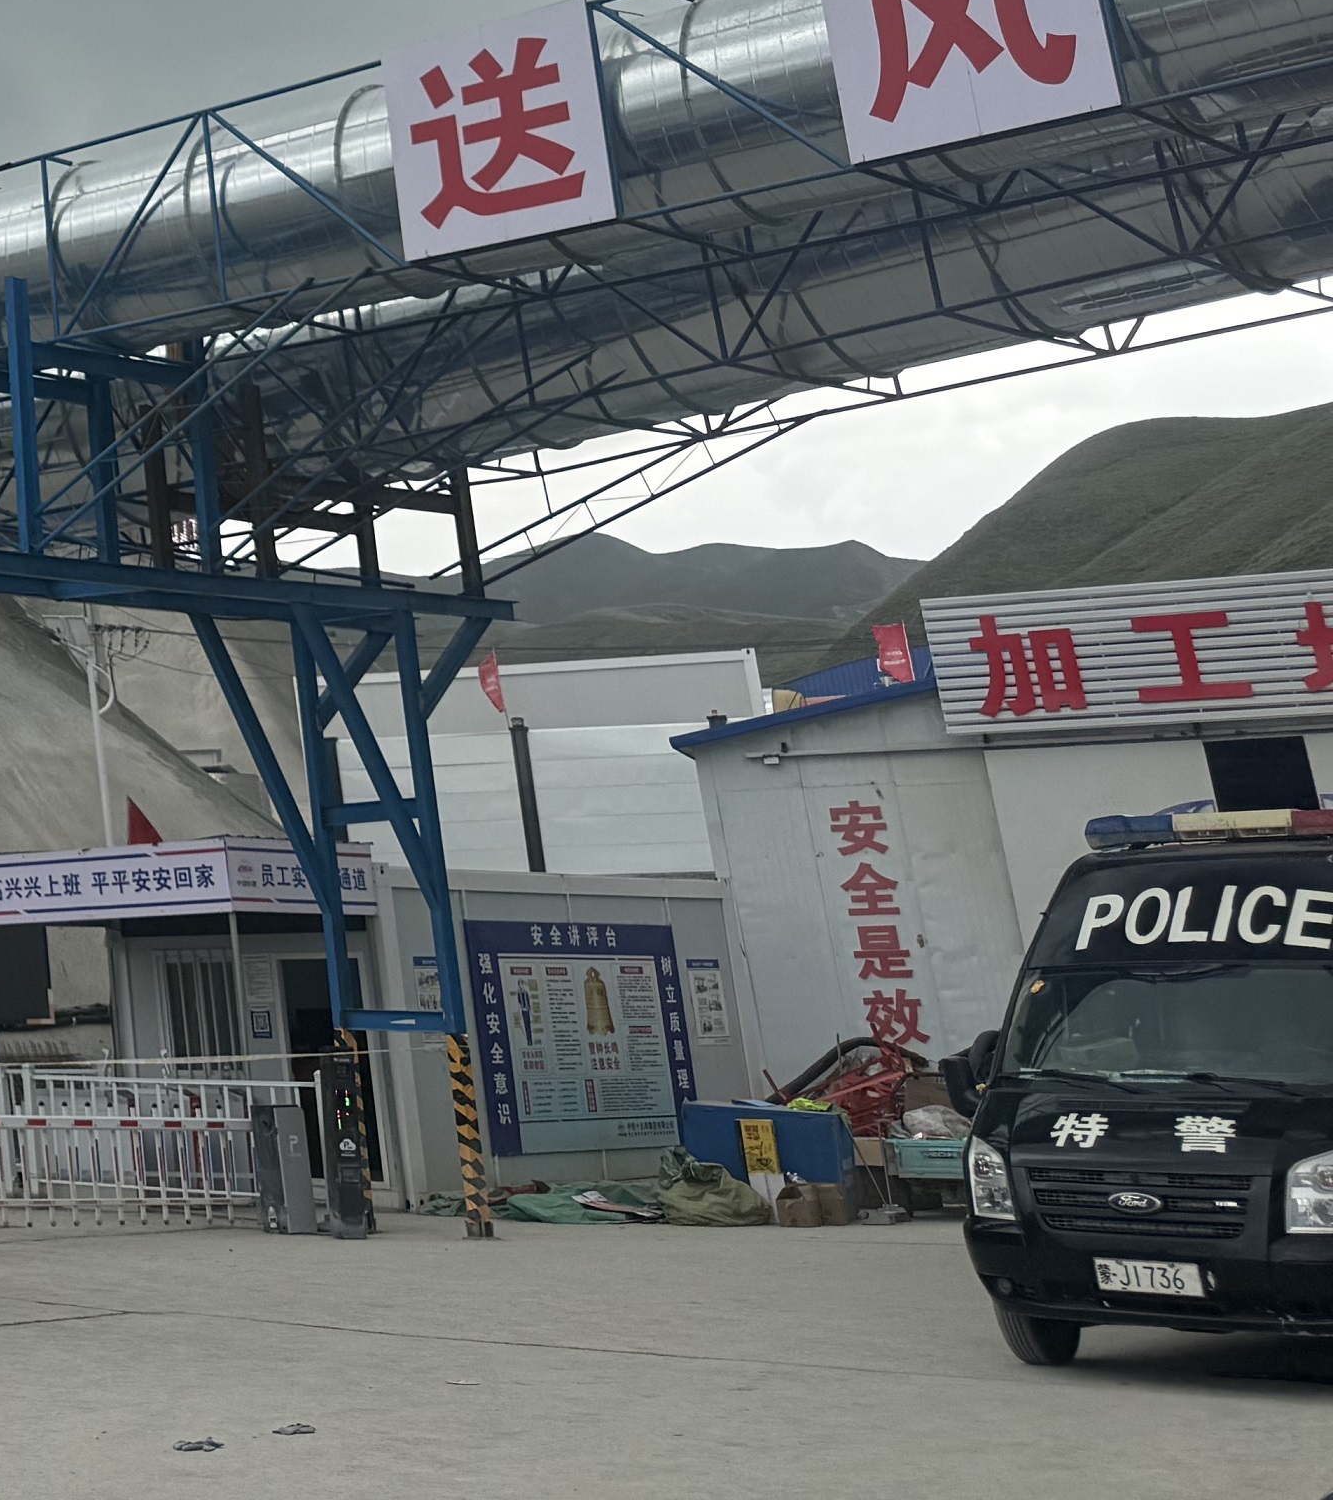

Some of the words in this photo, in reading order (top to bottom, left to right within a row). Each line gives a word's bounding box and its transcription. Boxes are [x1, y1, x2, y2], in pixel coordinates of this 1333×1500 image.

[411, 37, 586, 230] 送
[91, 863, 215, 895] 平平安安回家
[262, 863, 368, 891] 员工实通道
[530, 924, 616, 947] 安全讲评台
[829, 801, 931, 1045] 安全是效
[1074, 885, 1333, 950] POLICE
[477, 953, 512, 1125] 强化安全意识
[660, 955, 691, 1102] 树立质量理
[1050, 1113, 1237, 1153] 特警
[1118, 1195, 1148, 1208] Ford
